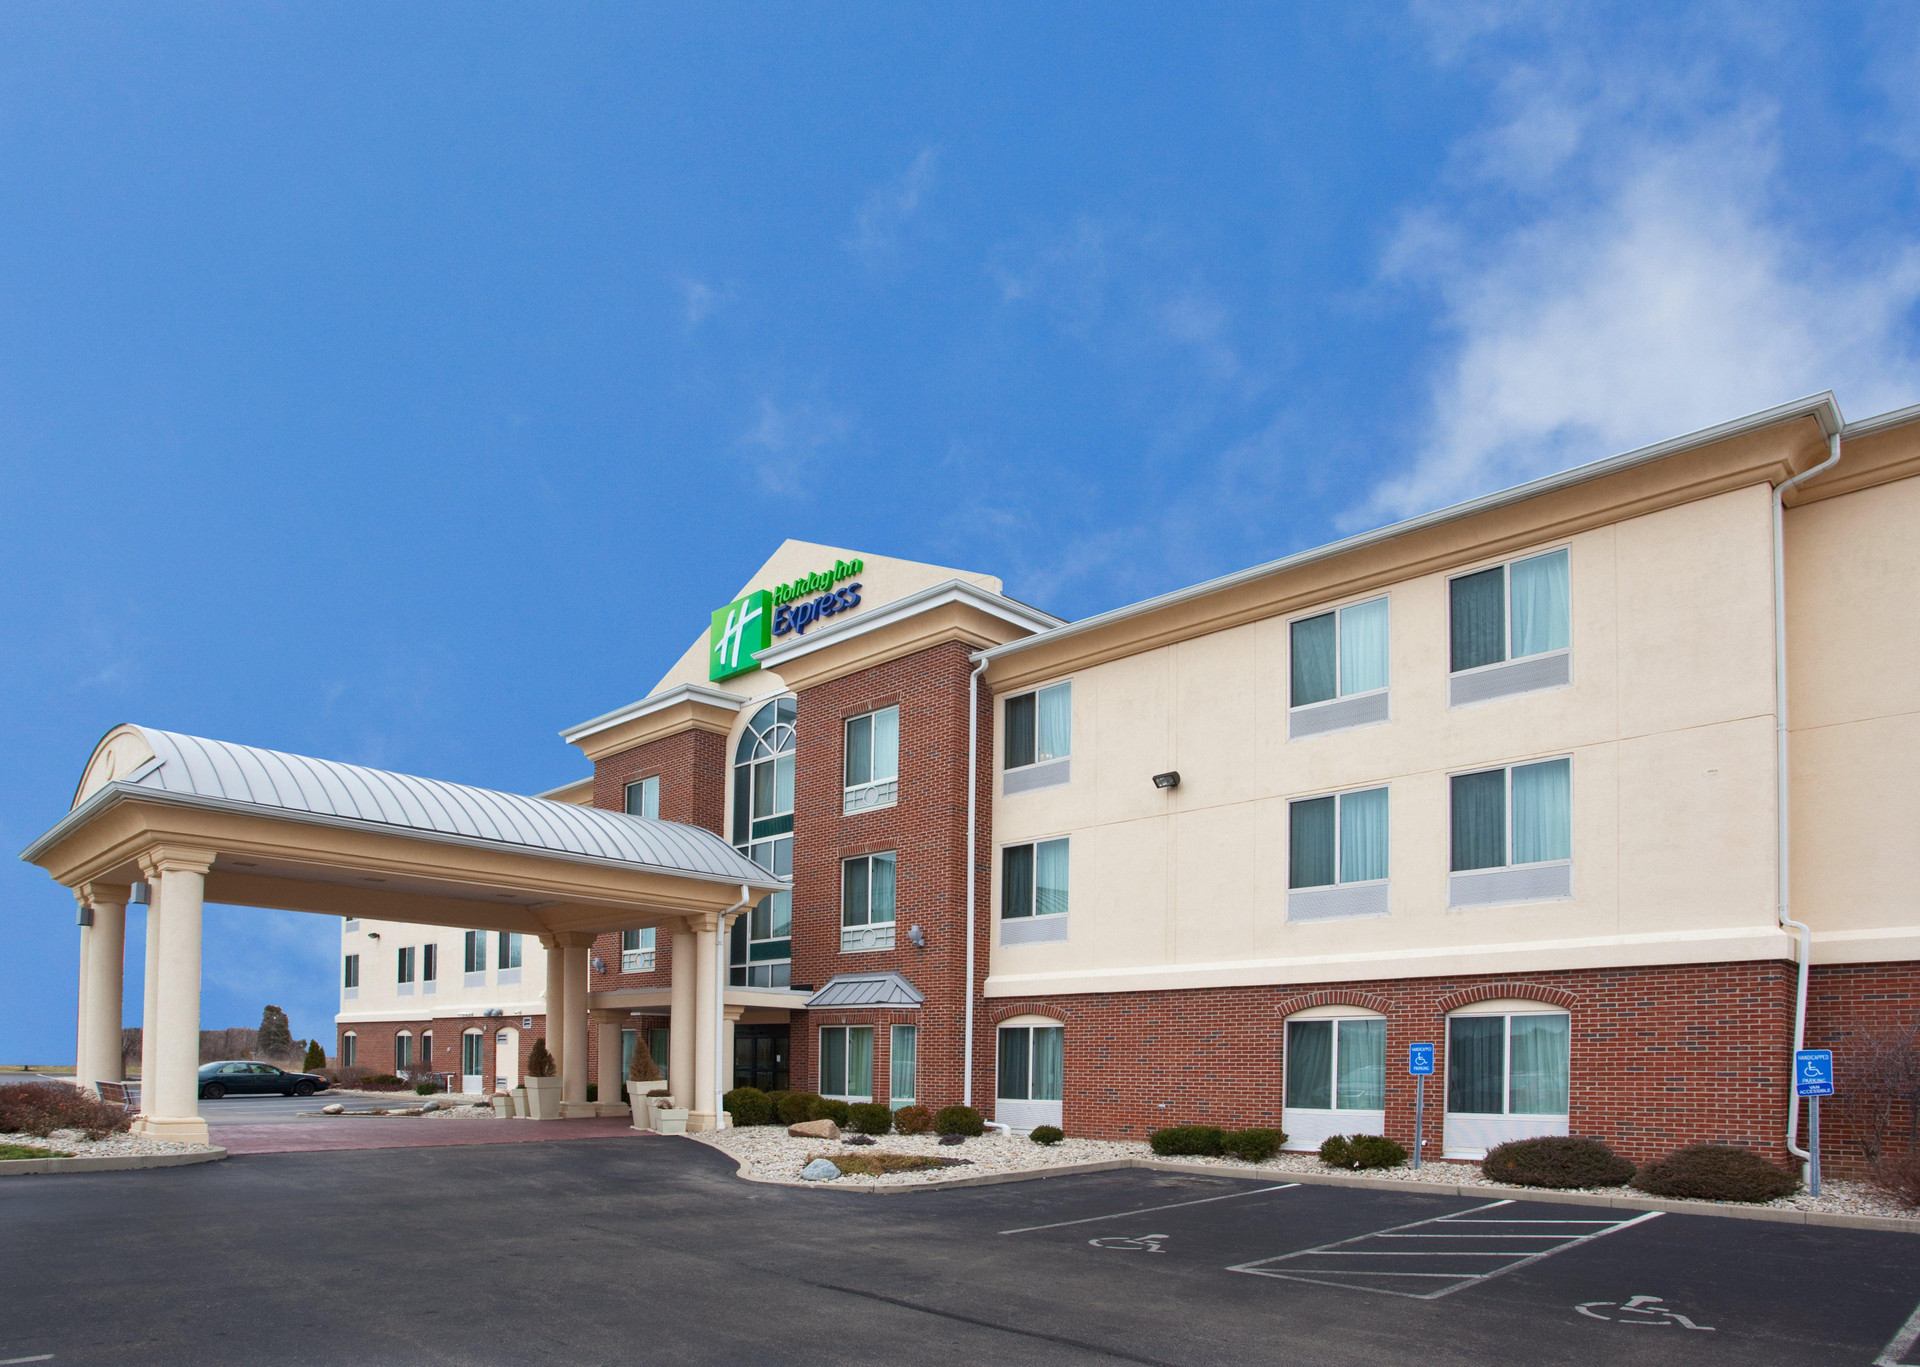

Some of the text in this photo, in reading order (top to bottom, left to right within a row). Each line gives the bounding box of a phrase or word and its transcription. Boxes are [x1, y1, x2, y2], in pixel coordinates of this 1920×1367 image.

[772, 582, 862, 636] Express
[773, 558, 864, 607] Holiday Inn
[714, 599, 763, 668] H
